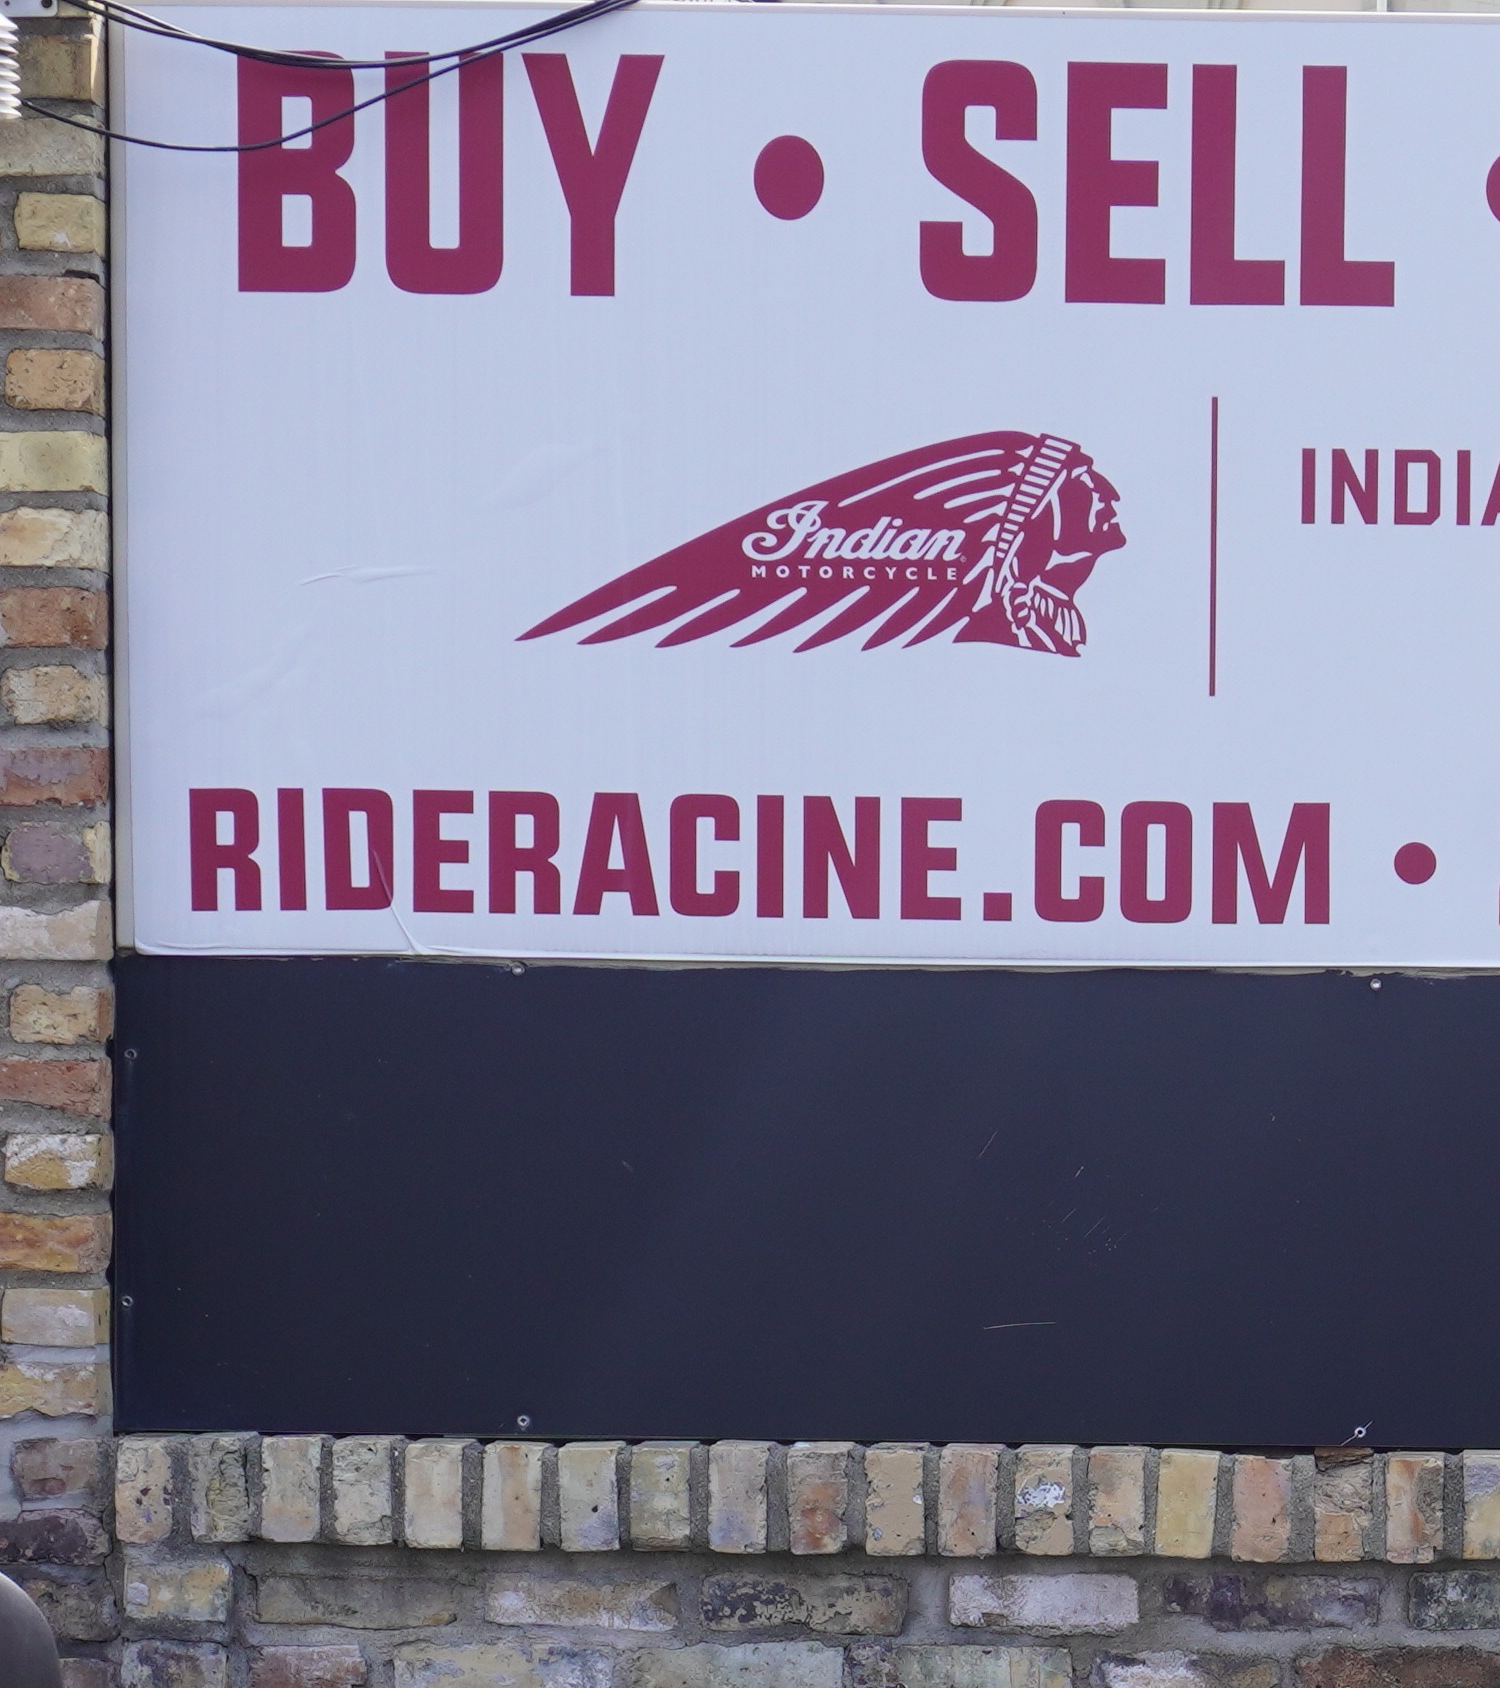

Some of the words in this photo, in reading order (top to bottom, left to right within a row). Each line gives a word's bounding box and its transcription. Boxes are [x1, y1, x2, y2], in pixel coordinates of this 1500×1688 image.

[237, 51, 664, 297] BUY
[919, 59, 1395, 307] SELL
[741, 500, 966, 561] Indian
[751, 565, 958, 581] MOTORCYCLE
[189, 787, 1331, 925] RIDERACINE.COM
